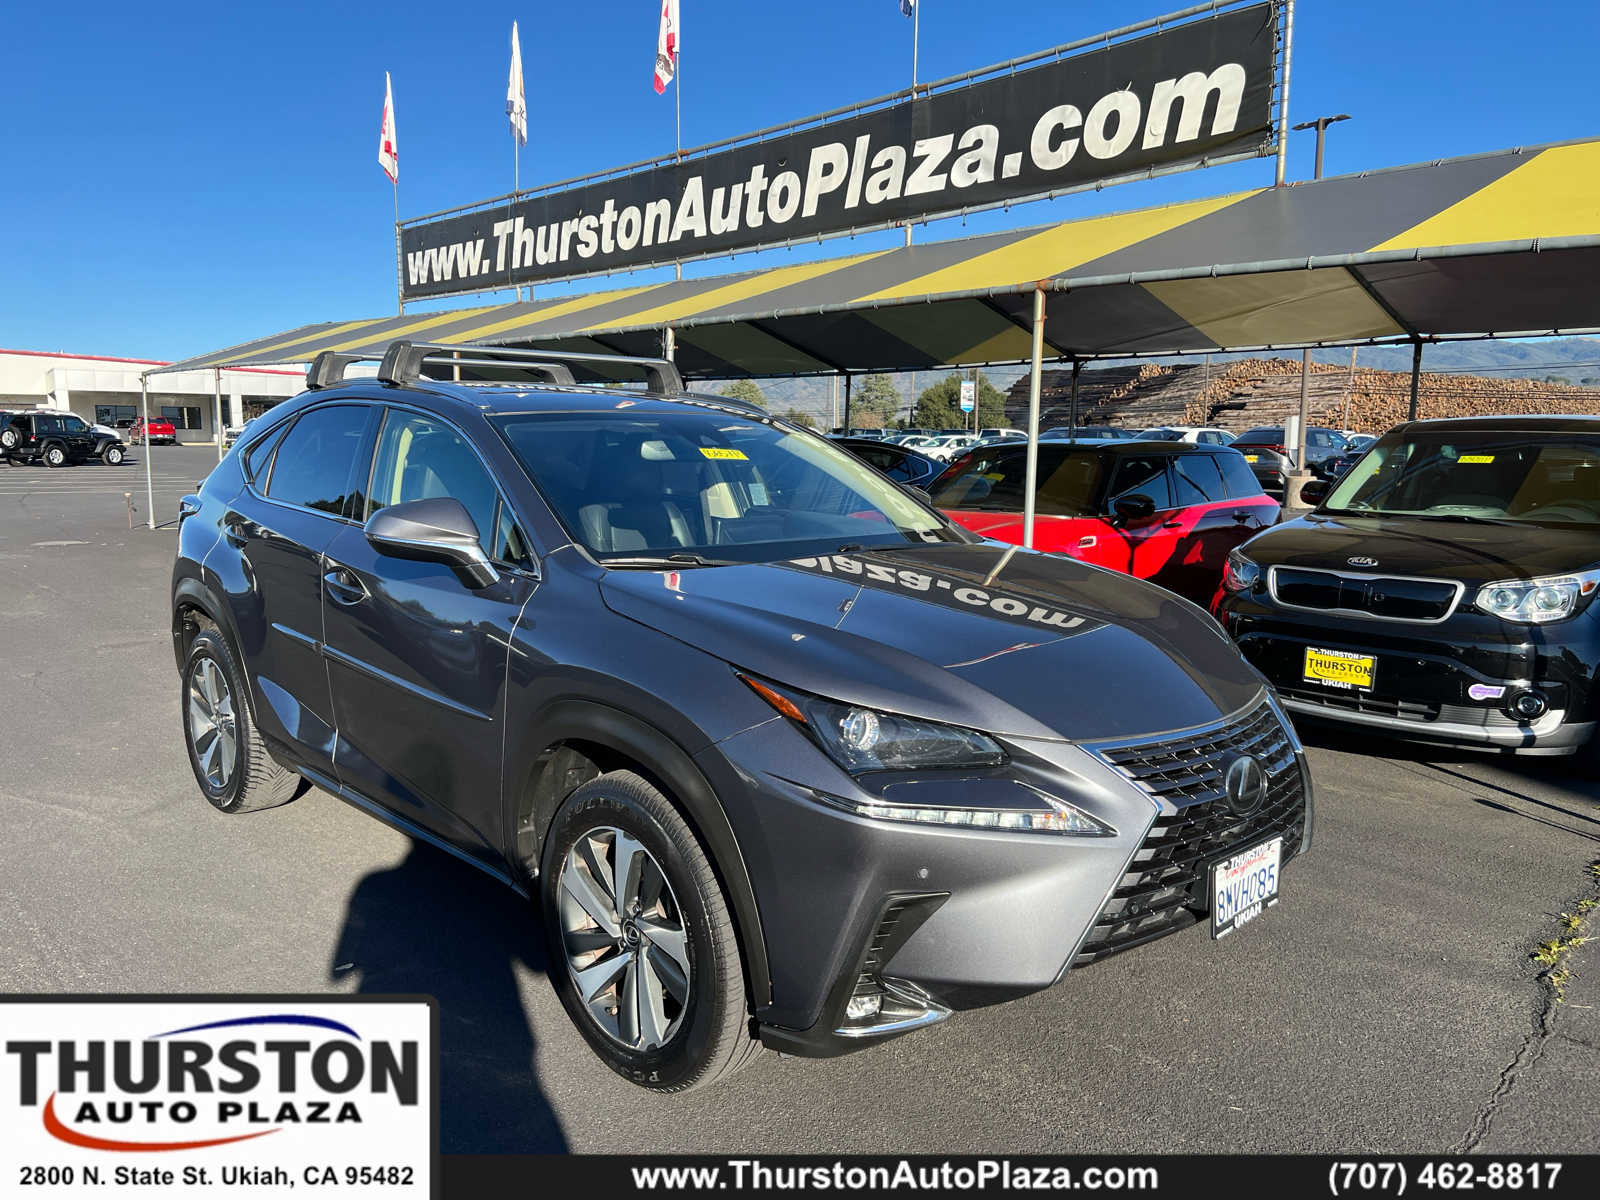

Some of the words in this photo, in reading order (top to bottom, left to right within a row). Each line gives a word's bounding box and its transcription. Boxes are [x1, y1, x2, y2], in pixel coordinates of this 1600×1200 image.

[407, 62, 1246, 287] www.ThurstonAutoPlaza.com
[1320, 648, 1360, 660] THURSTON
[1308, 658, 1372, 677] THURSTON
[1321, 679, 1352, 690] UKIAH
[1217, 863, 1276, 923] 8MVH085
[1234, 902, 1263, 929] UKIAH
